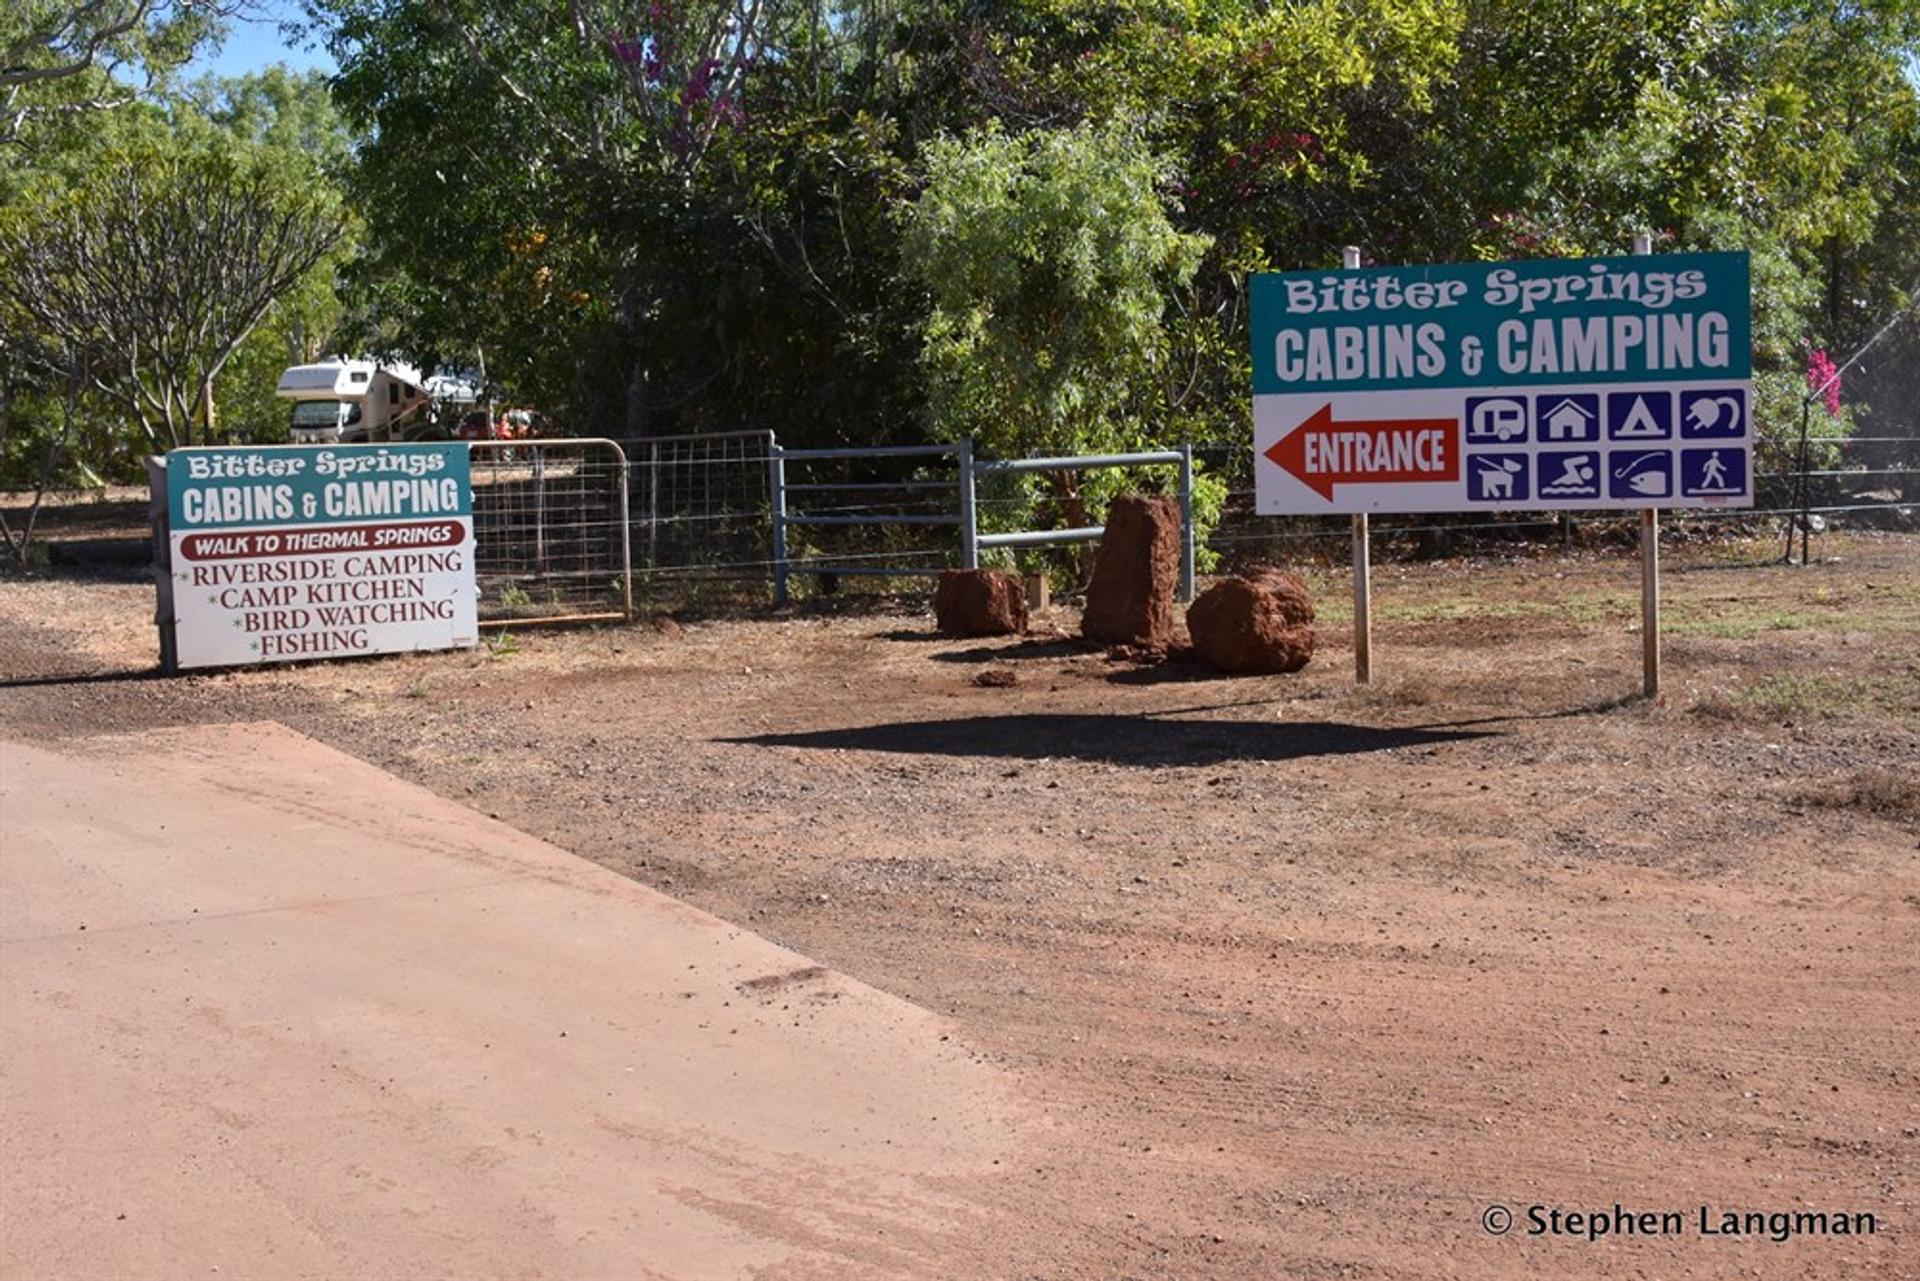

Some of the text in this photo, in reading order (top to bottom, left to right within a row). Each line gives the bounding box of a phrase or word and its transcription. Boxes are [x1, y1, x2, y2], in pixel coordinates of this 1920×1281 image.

[1284, 264, 1707, 313] Bitter Springs
[1275, 312, 1729, 381] CABINS & CAMPING
[187, 450, 445, 479] Bitter Springs
[1305, 429, 1445, 473] ENTRANCE
[183, 478, 459, 523] CABINS & CAMPING
[195, 526, 453, 556] WALK TO THERMAL SPRINGS
[193, 551, 462, 586] RIVERSIDE CAMPING
[220, 578, 424, 609] CAMP KITCHEN
[244, 600, 454, 632] BIRD WATCHING
[261, 629, 368, 655] FISHING
